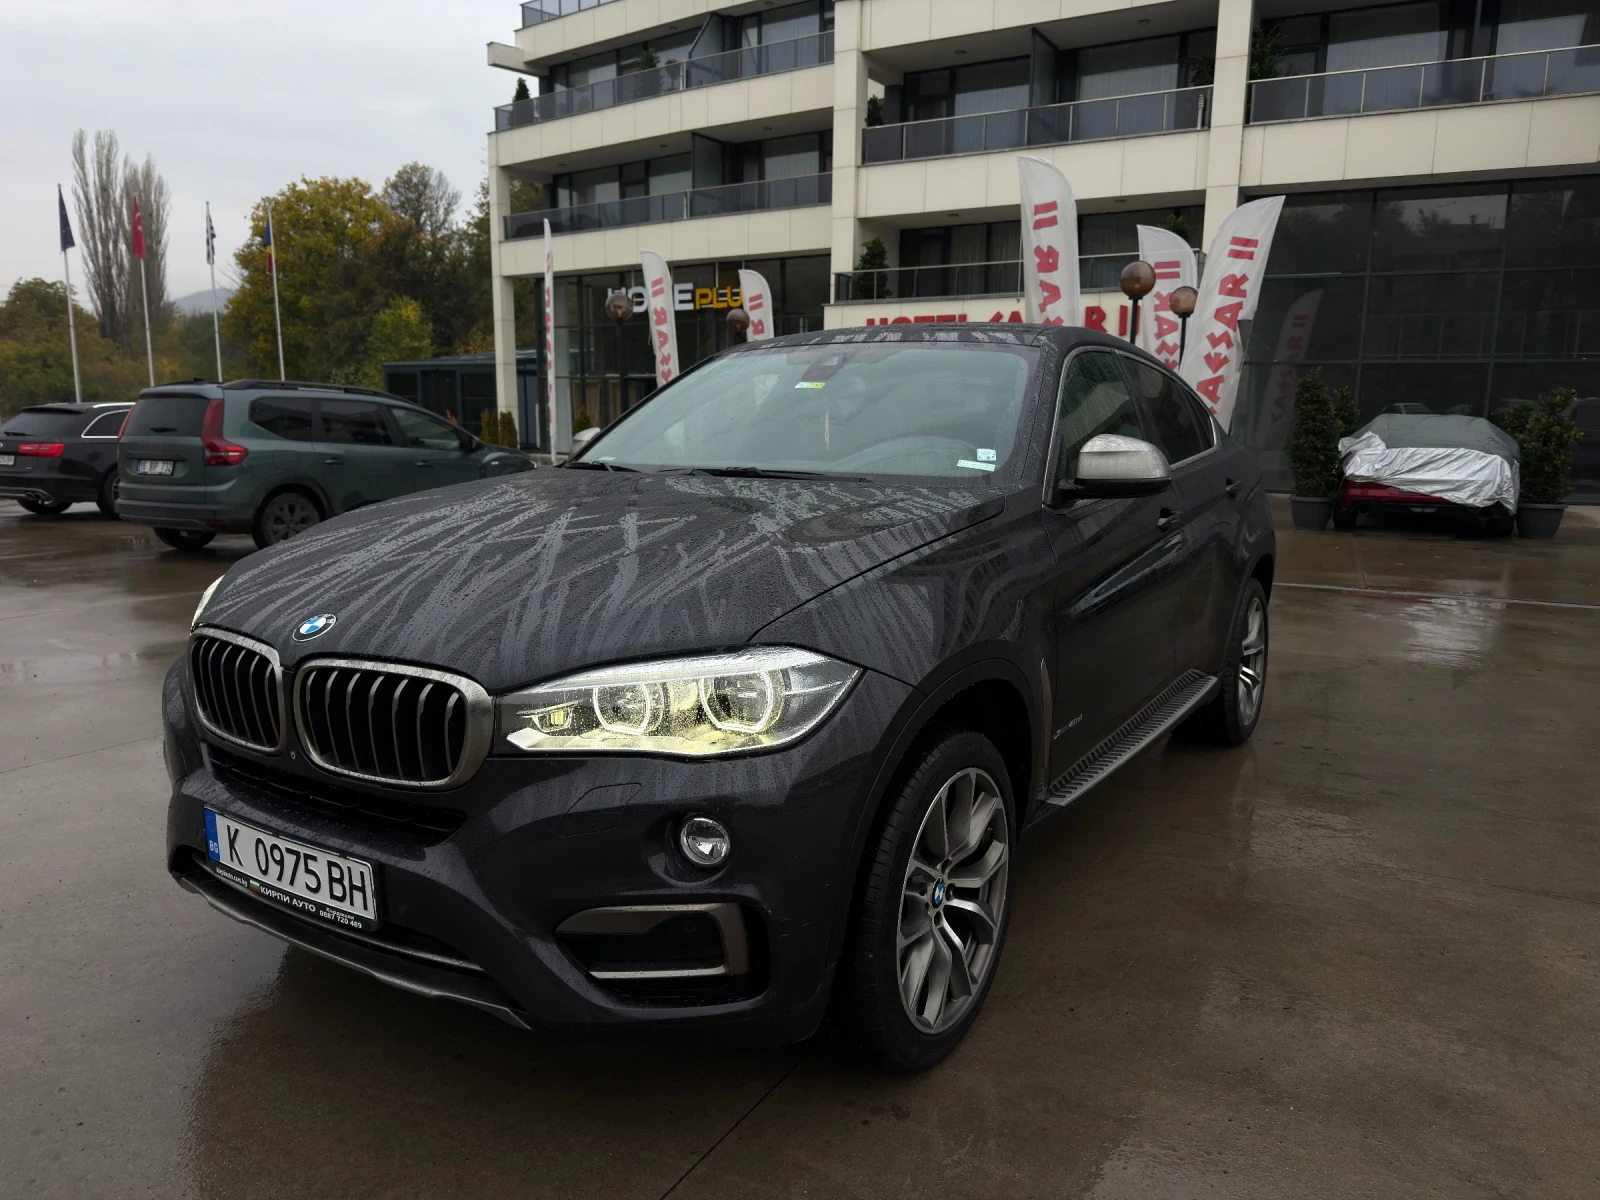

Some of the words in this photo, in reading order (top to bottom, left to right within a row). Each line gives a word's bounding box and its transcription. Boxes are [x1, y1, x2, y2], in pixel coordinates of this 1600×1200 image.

[1196, 273, 1250, 415] AESAR
[1227, 236, 1259, 260] II
[209, 840, 220, 854] BG
[255, 837, 321, 894] 0975
[260, 885, 290, 904] КИРПИ
